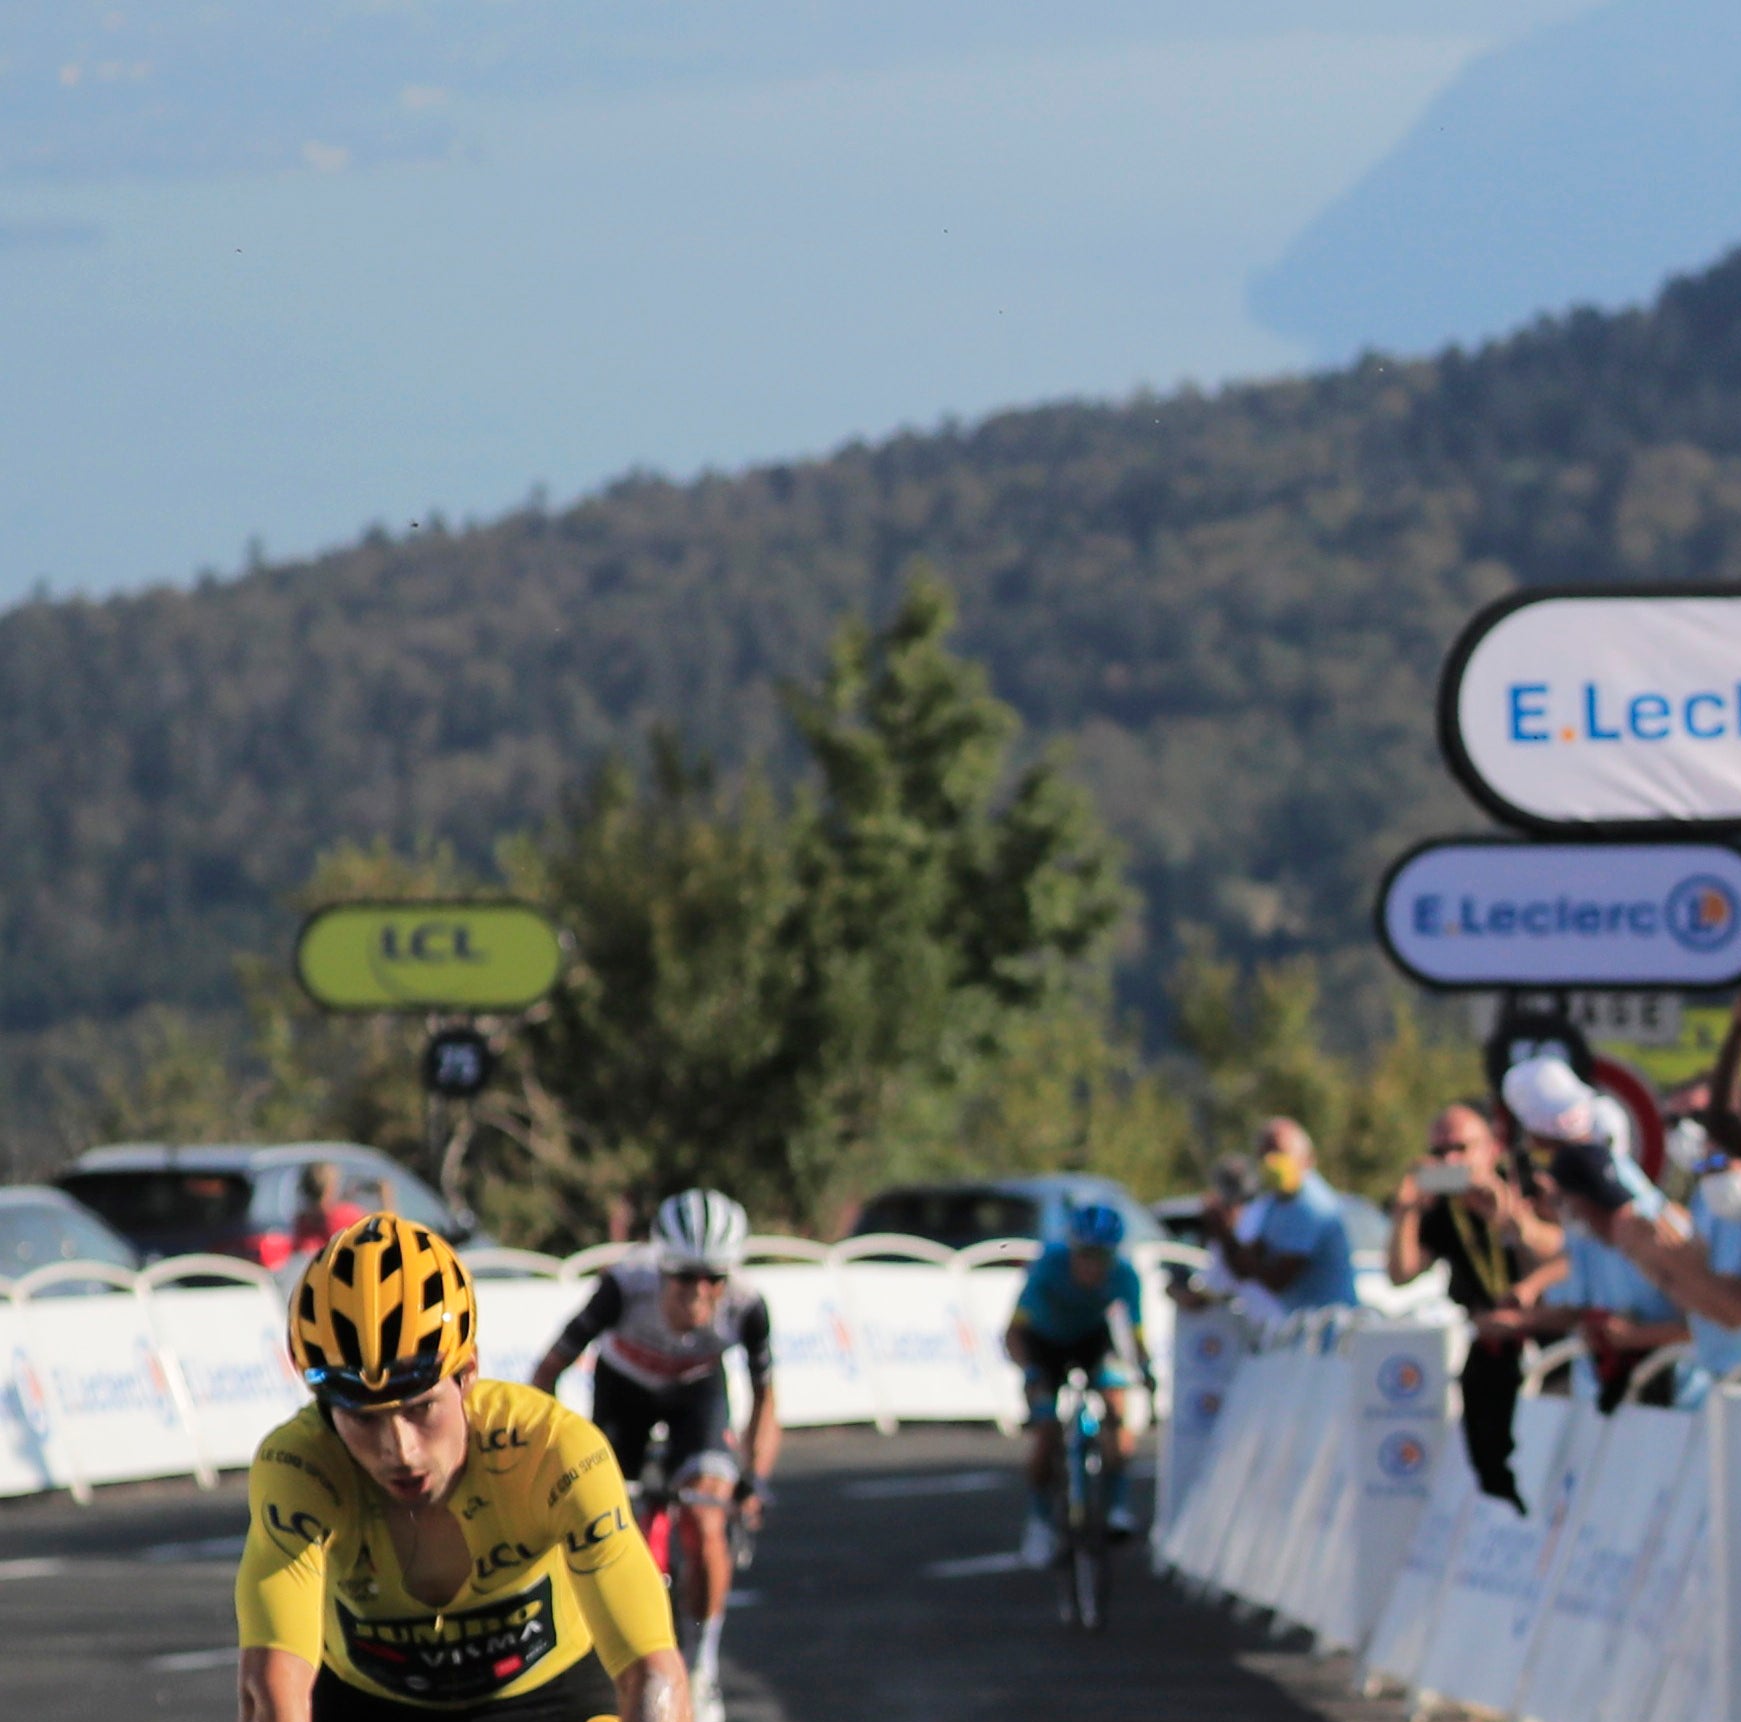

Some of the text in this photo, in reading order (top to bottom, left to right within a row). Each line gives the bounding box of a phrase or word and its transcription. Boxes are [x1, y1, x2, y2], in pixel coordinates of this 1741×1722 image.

[1413, 893, 1667, 936] E.Leclerc
[382, 924, 488, 966] LCL
[566, 1505, 629, 1553] LCL
[476, 1541, 535, 1578] LCL
